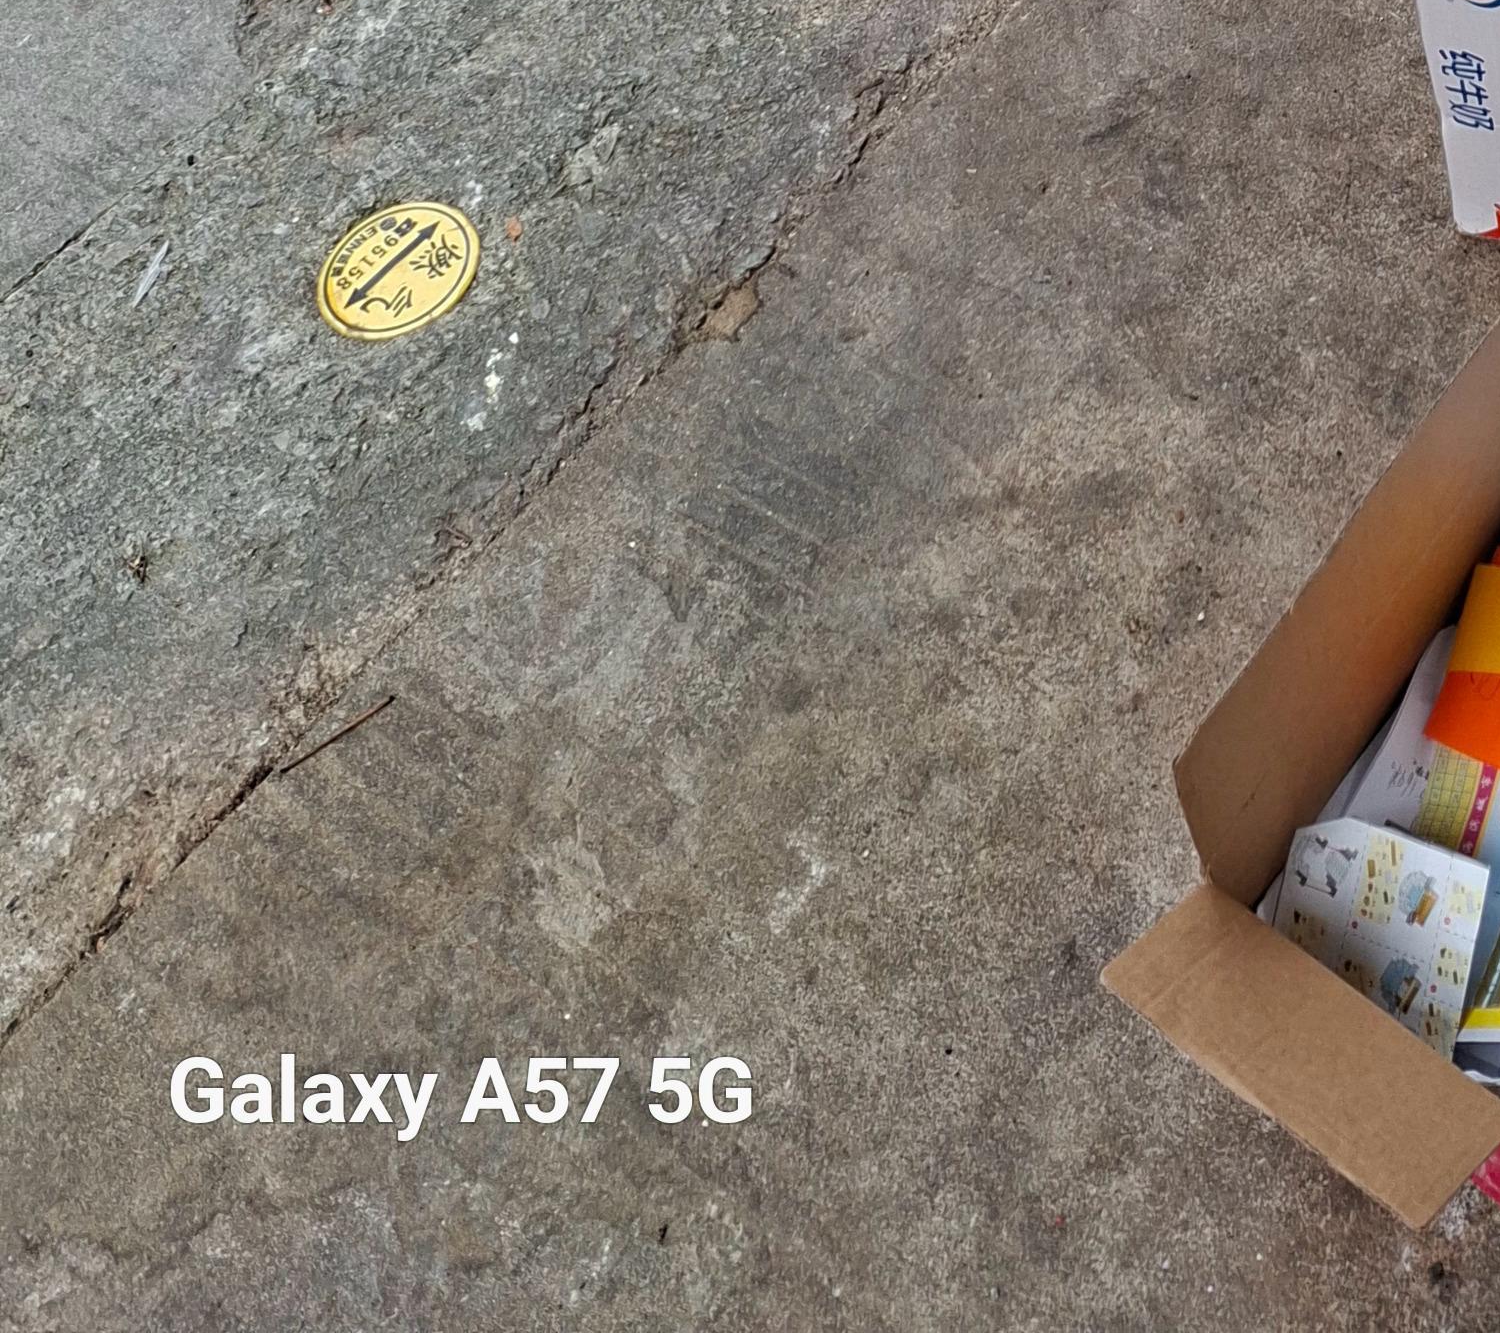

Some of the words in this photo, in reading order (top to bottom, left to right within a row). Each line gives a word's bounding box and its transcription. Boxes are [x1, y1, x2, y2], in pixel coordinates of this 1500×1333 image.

[1438, 49, 1495, 131] 纯牛奶
[337, 235, 398, 290] 95158
[360, 233, 463, 318] 燃气
